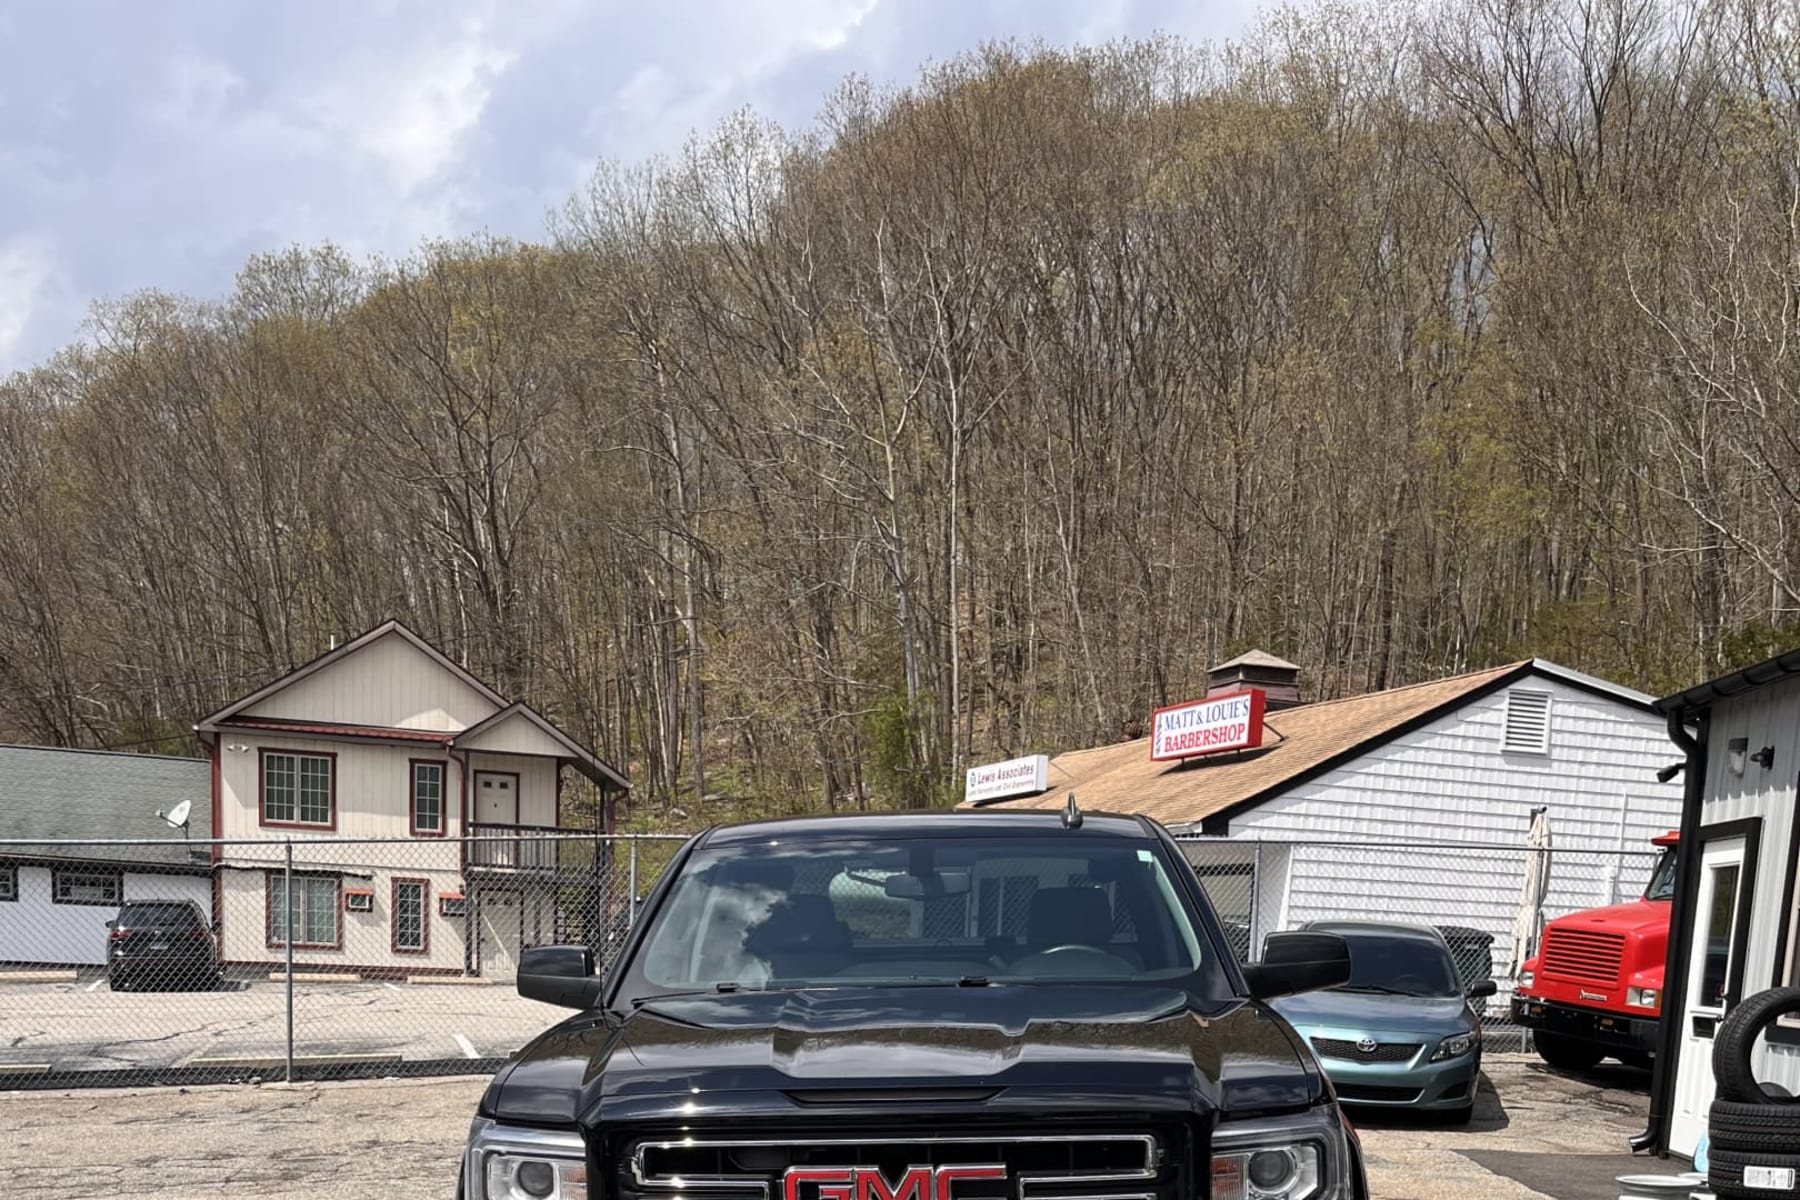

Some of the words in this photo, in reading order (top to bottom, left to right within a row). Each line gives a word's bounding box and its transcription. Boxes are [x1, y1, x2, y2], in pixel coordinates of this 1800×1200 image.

[1165, 709, 1196, 730] MATT
[1196, 711, 1204, 725] &
[1206, 698, 1249, 723] LOUIE'S
[1164, 723, 1245, 752] BARBERSHOP
[978, 772, 995, 784] Lewis
[998, 764, 1034, 780] Associates
